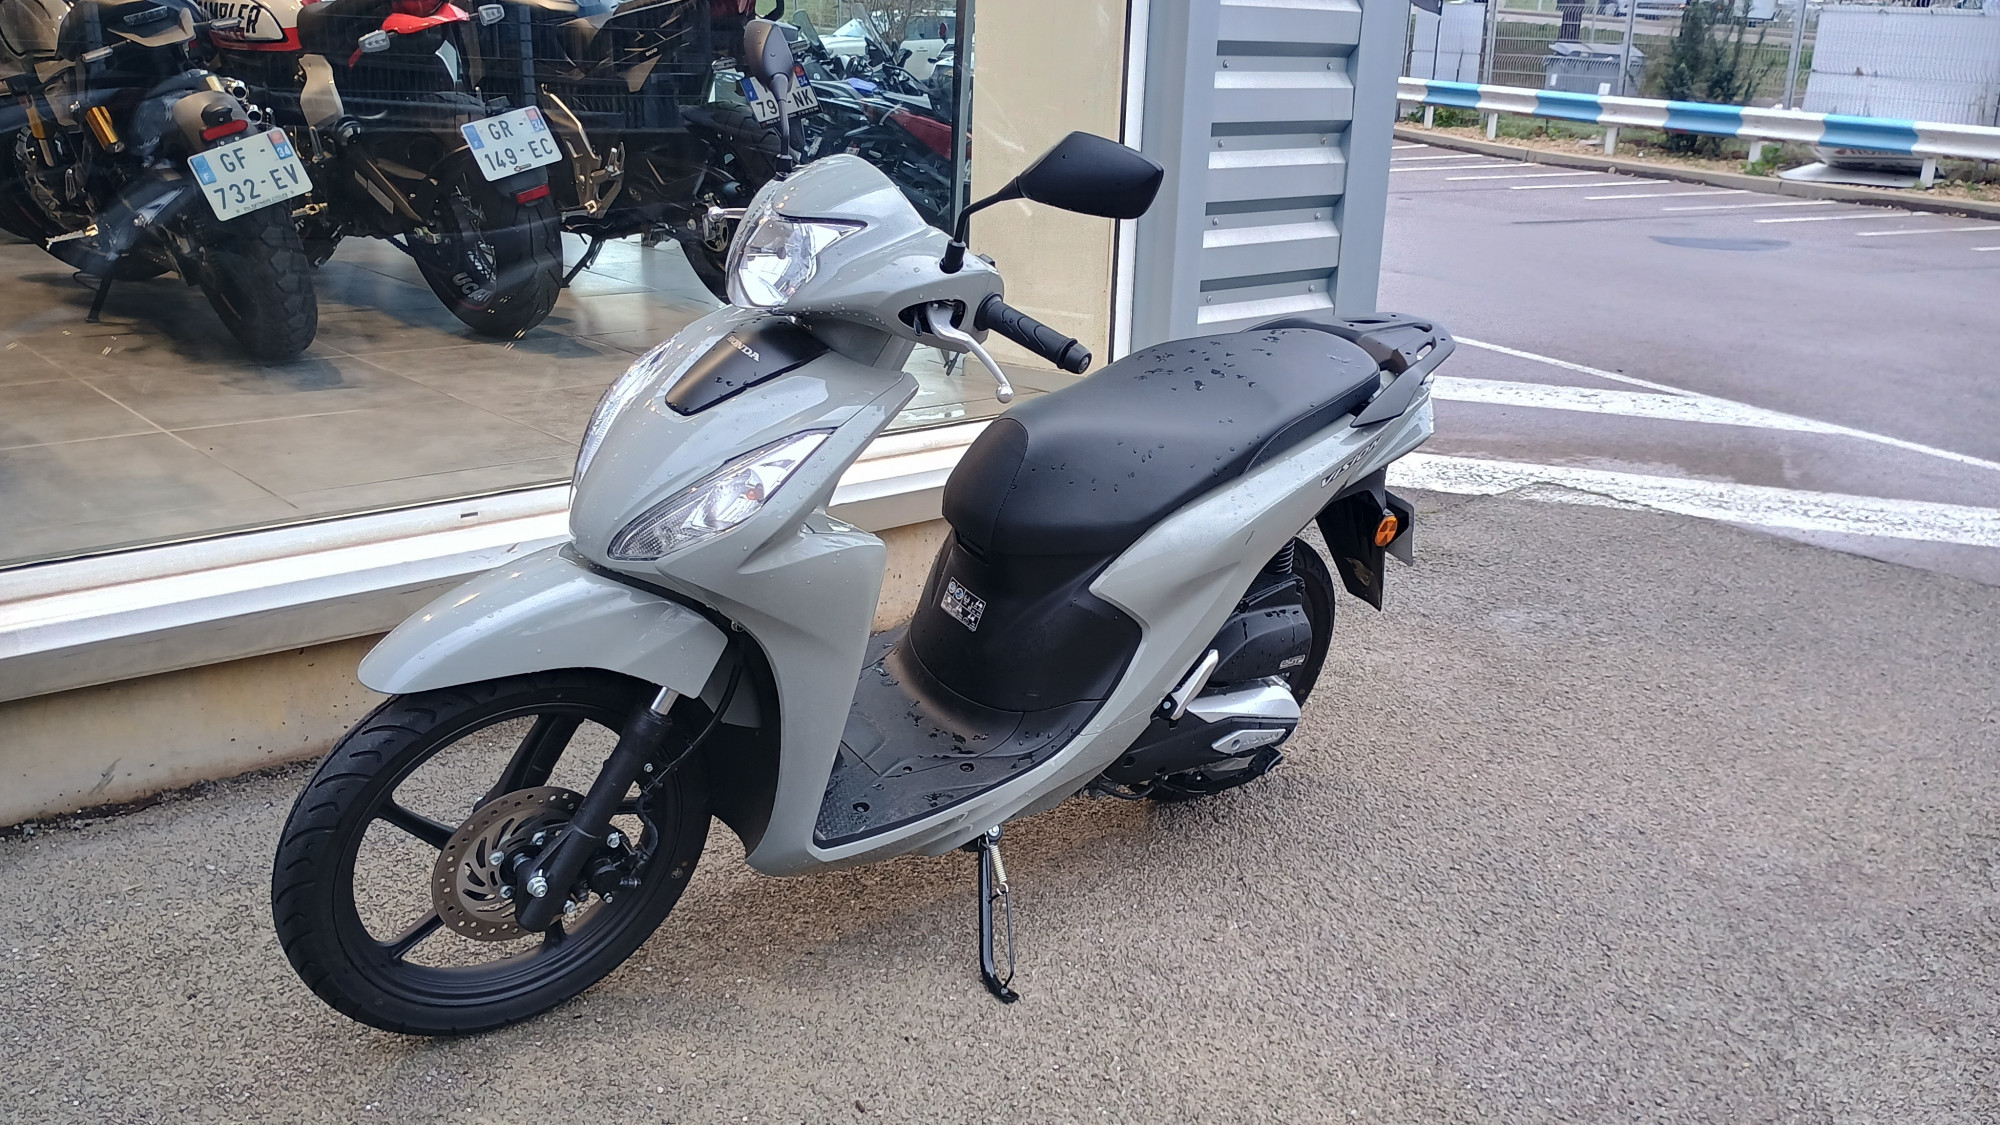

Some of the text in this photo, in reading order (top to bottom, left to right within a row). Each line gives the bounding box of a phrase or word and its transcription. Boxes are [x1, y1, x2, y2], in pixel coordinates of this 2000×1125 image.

[487, 120, 514, 140] GR
[531, 121, 545, 132] 34
[219, 147, 245, 173] GF
[276, 146, 291, 158] 34
[726, 335, 760, 362] HONDA
[1321, 434, 1384, 488] VISION
